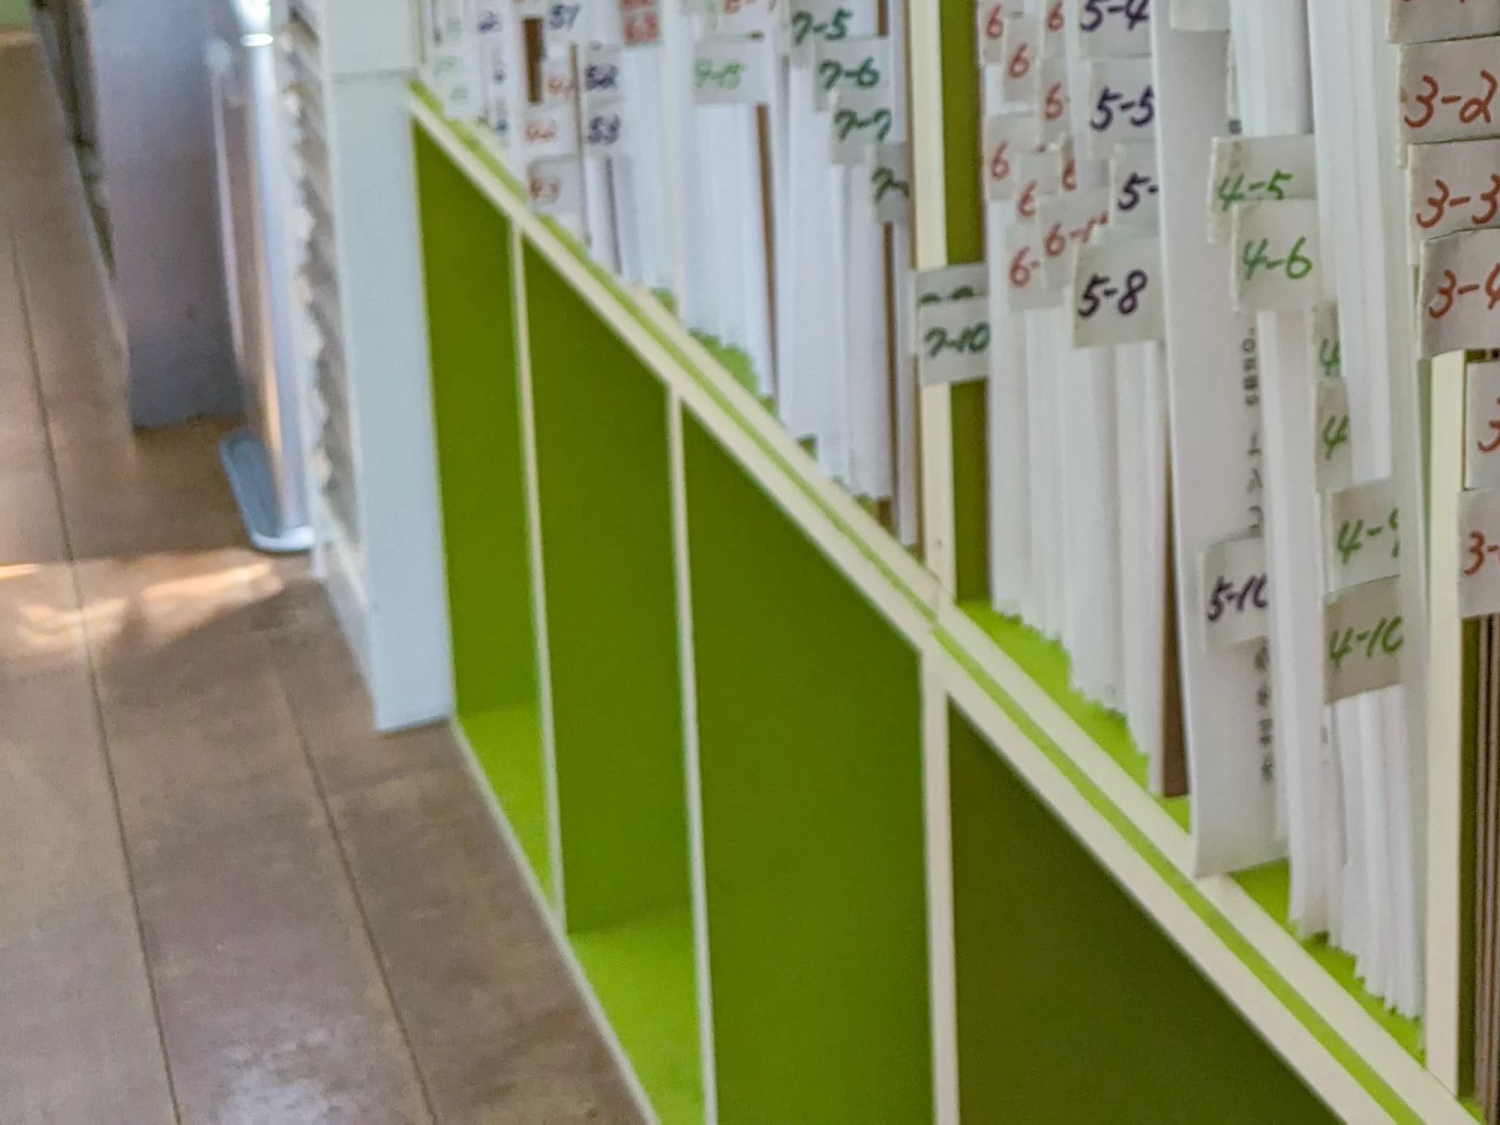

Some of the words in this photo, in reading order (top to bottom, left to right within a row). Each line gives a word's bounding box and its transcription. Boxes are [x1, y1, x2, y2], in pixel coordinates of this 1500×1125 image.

[1404, 70, 1498, 128] 3-2
[1242, 237, 1312, 281] 4-6
[1077, 269, 1148, 318] 5-8
